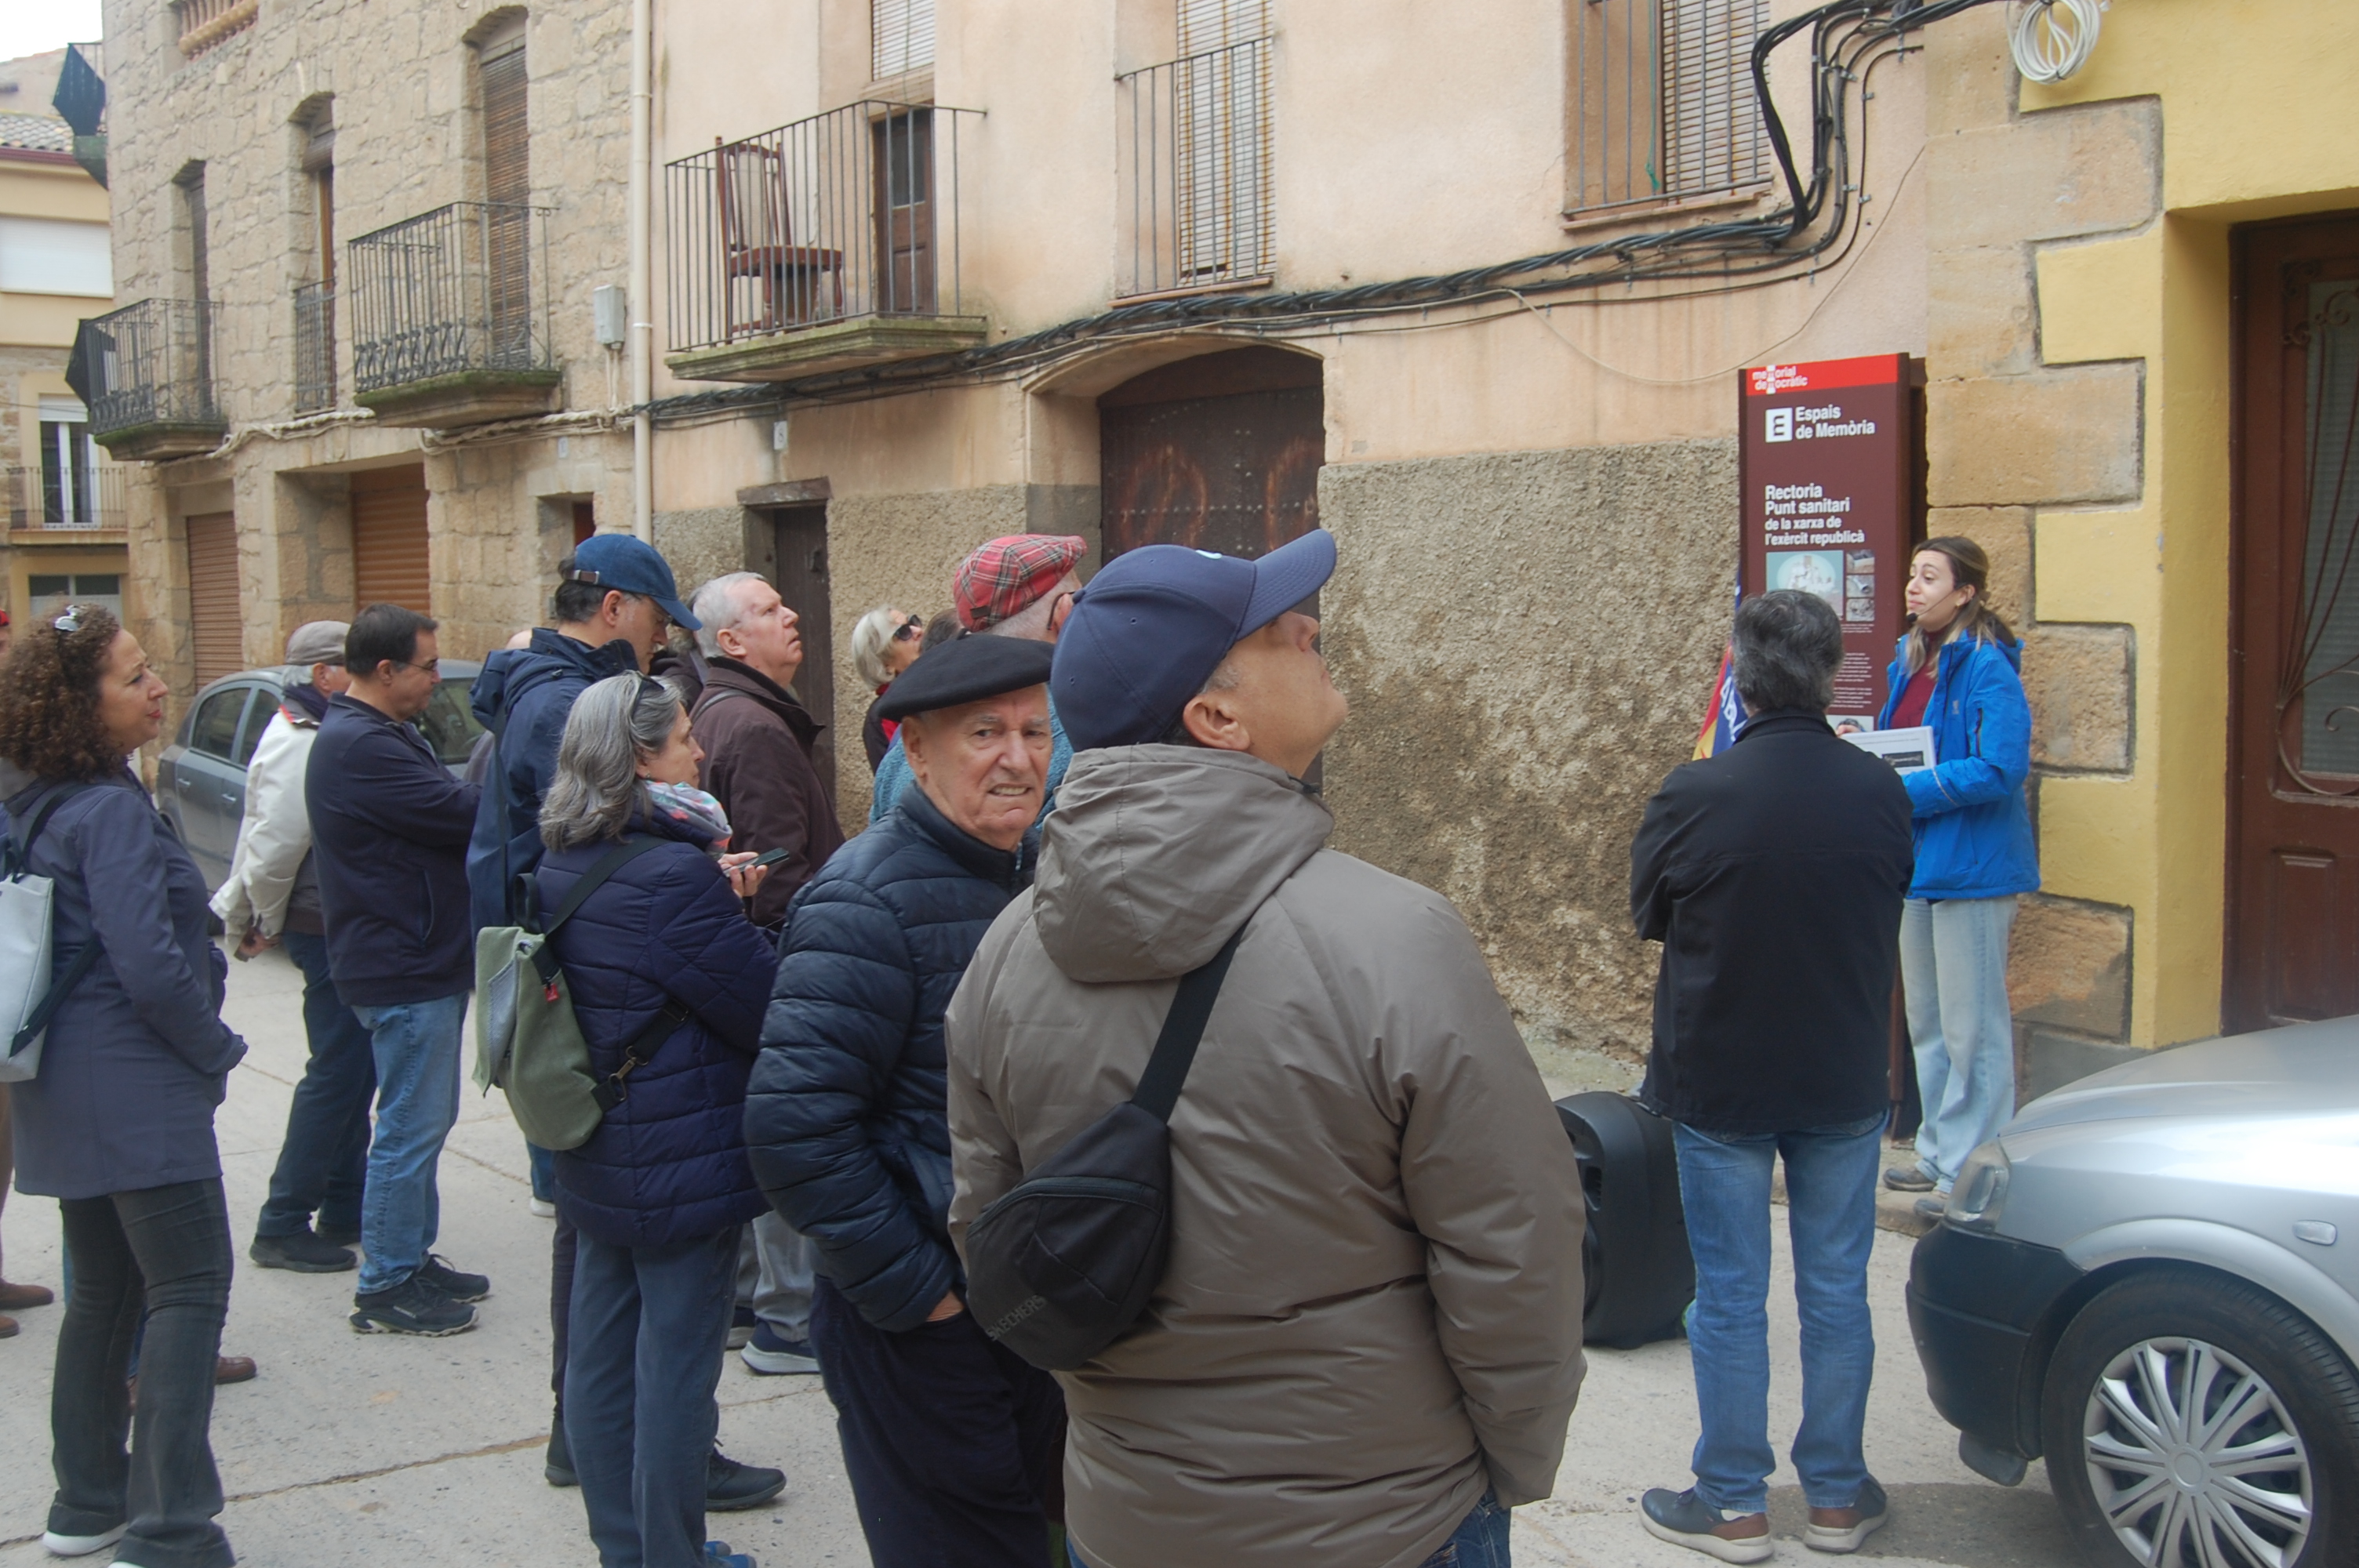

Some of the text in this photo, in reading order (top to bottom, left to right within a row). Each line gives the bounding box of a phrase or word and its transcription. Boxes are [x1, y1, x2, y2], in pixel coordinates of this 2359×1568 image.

[1795, 405, 1841, 423] Espais
[1795, 420, 1875, 440] de Memòria
[1765, 483, 1822, 500] Rectoria
[1765, 497, 1850, 515] Punt sanitari
[1765, 516, 1841, 531] de la xarxa de
[1765, 530, 1865, 546] l'exèrcit republicà
[985, 1294, 1048, 1341] SKECHERS
